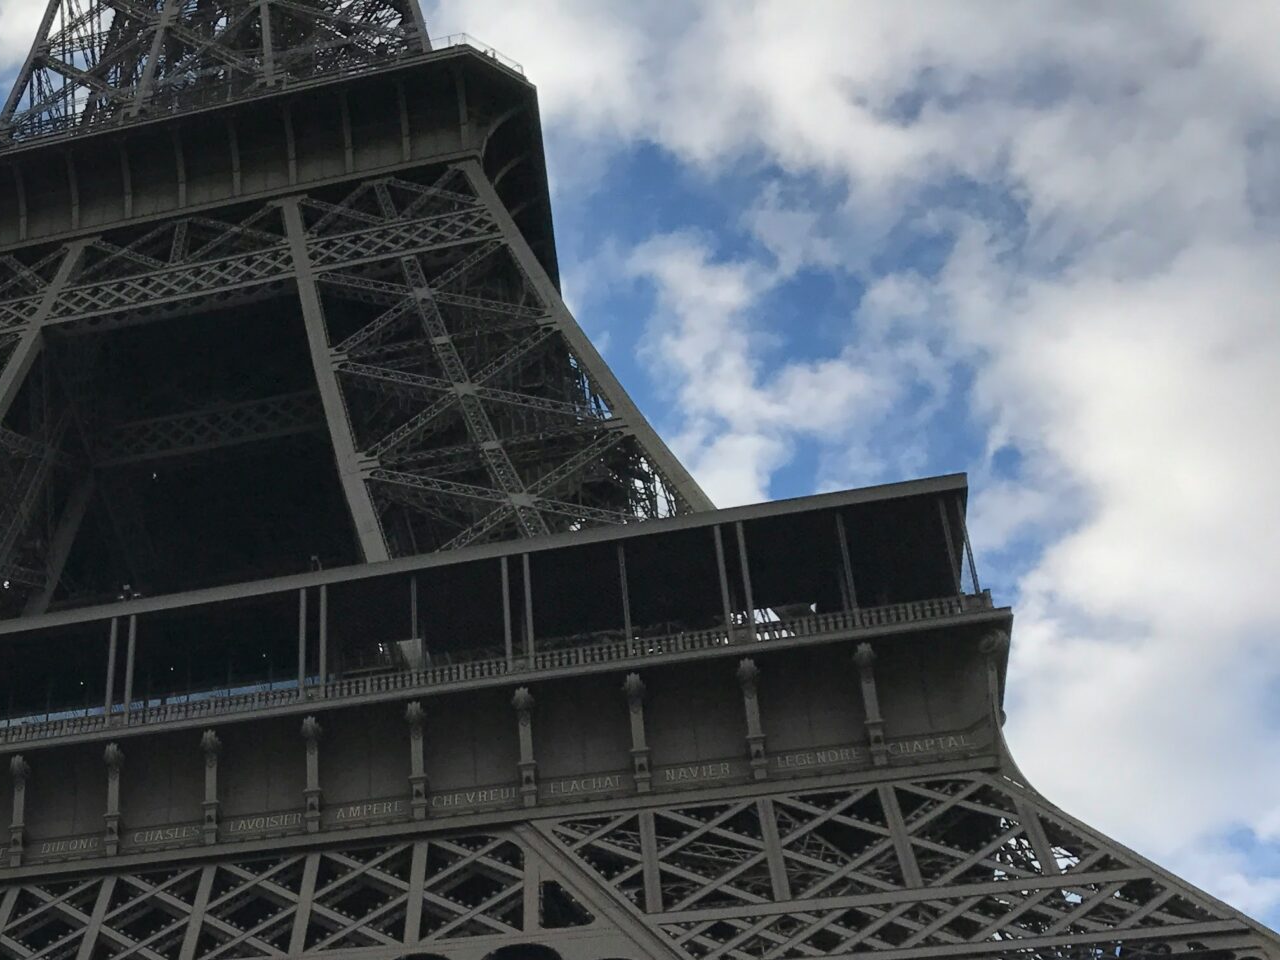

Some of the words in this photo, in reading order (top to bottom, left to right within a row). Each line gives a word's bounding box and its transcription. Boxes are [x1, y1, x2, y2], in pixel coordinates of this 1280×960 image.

[889, 735, 970, 754] CHAPTAL
[777, 748, 860, 768] LEGENDRE
[665, 763, 730, 781] NAVIER
[549, 775, 621, 794] FLACHAT
[336, 800, 403, 819] AMPERE
[229, 813, 303, 832] LAVOISIER
[134, 825, 201, 844] CHASLES
[41, 837, 99, 854] DULONG
